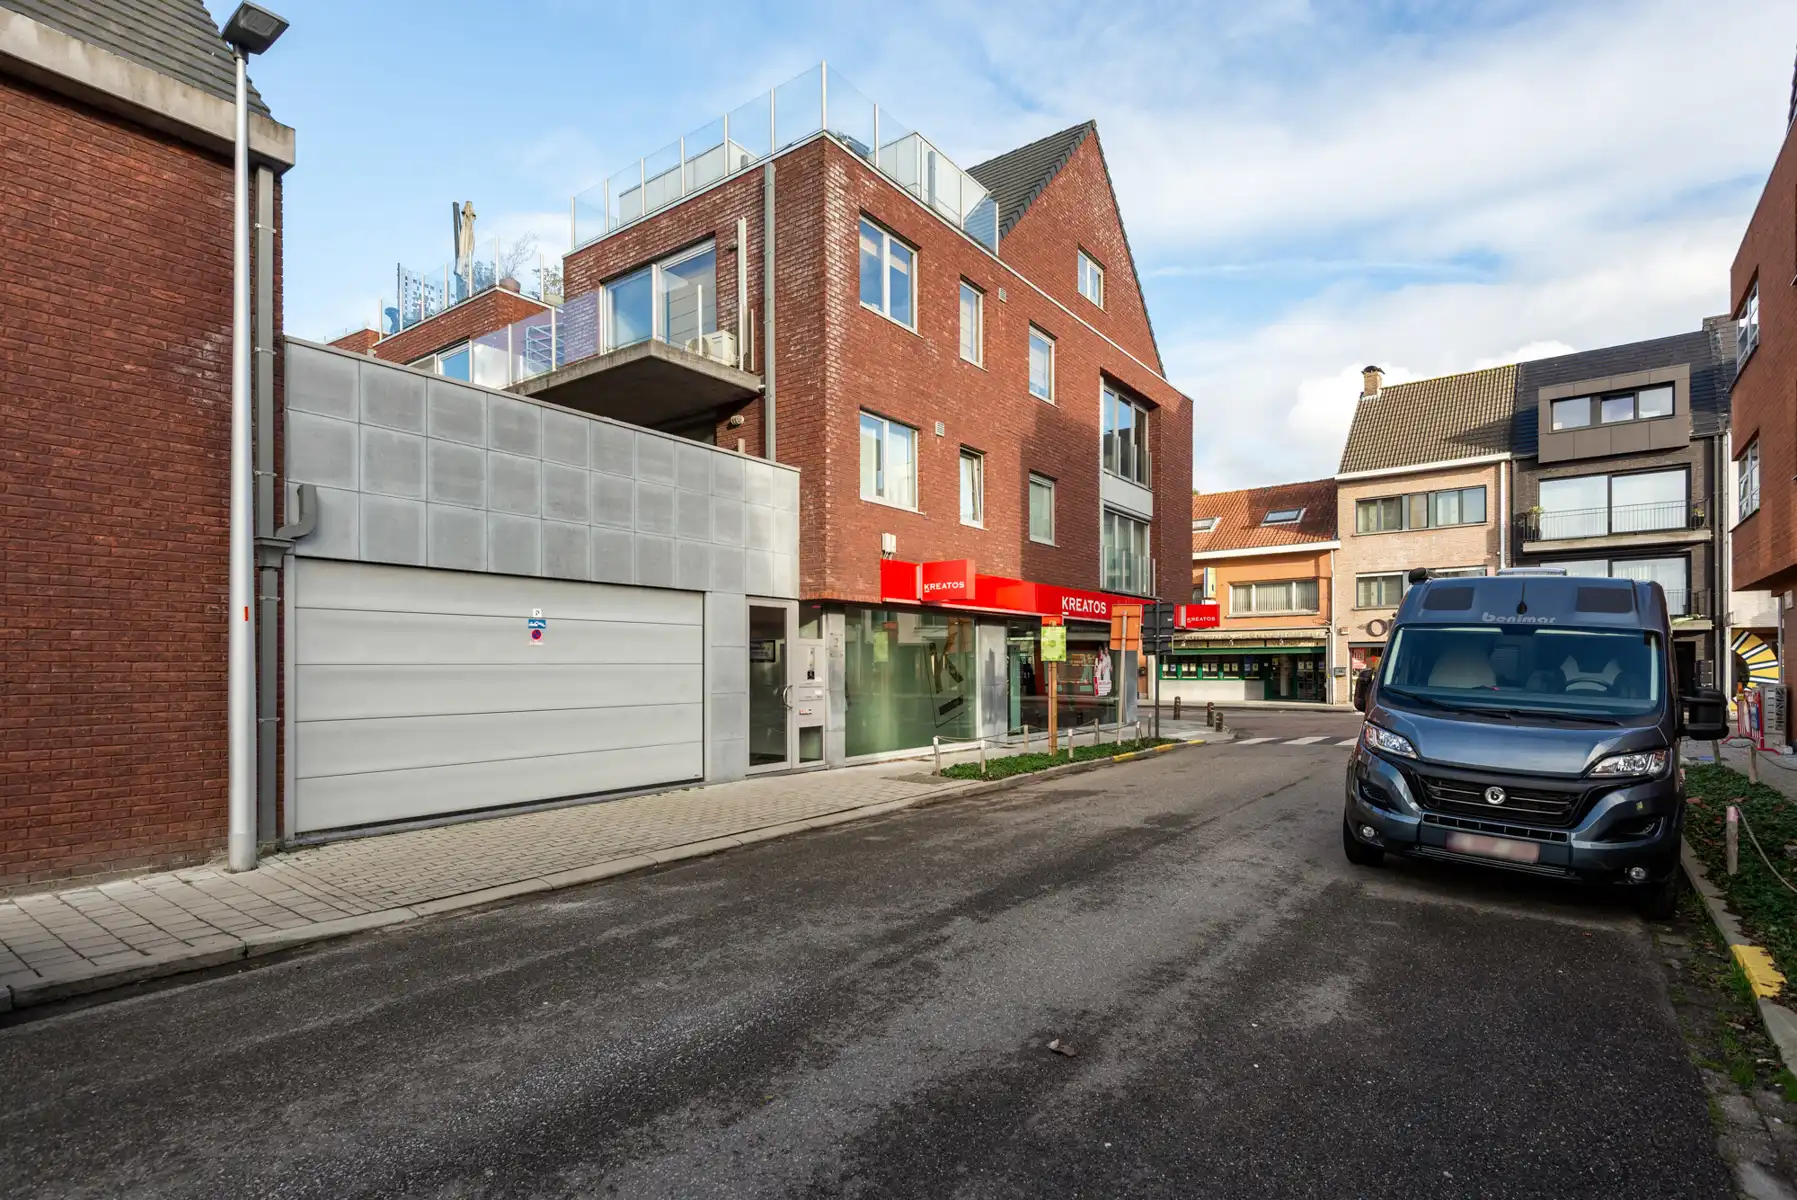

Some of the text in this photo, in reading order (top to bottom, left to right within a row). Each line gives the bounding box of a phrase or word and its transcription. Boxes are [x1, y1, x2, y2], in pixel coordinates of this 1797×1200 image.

[924, 581, 965, 593] KREATOS
[1061, 596, 1107, 614] KREATOS
[1482, 612, 1556, 624] benimar
